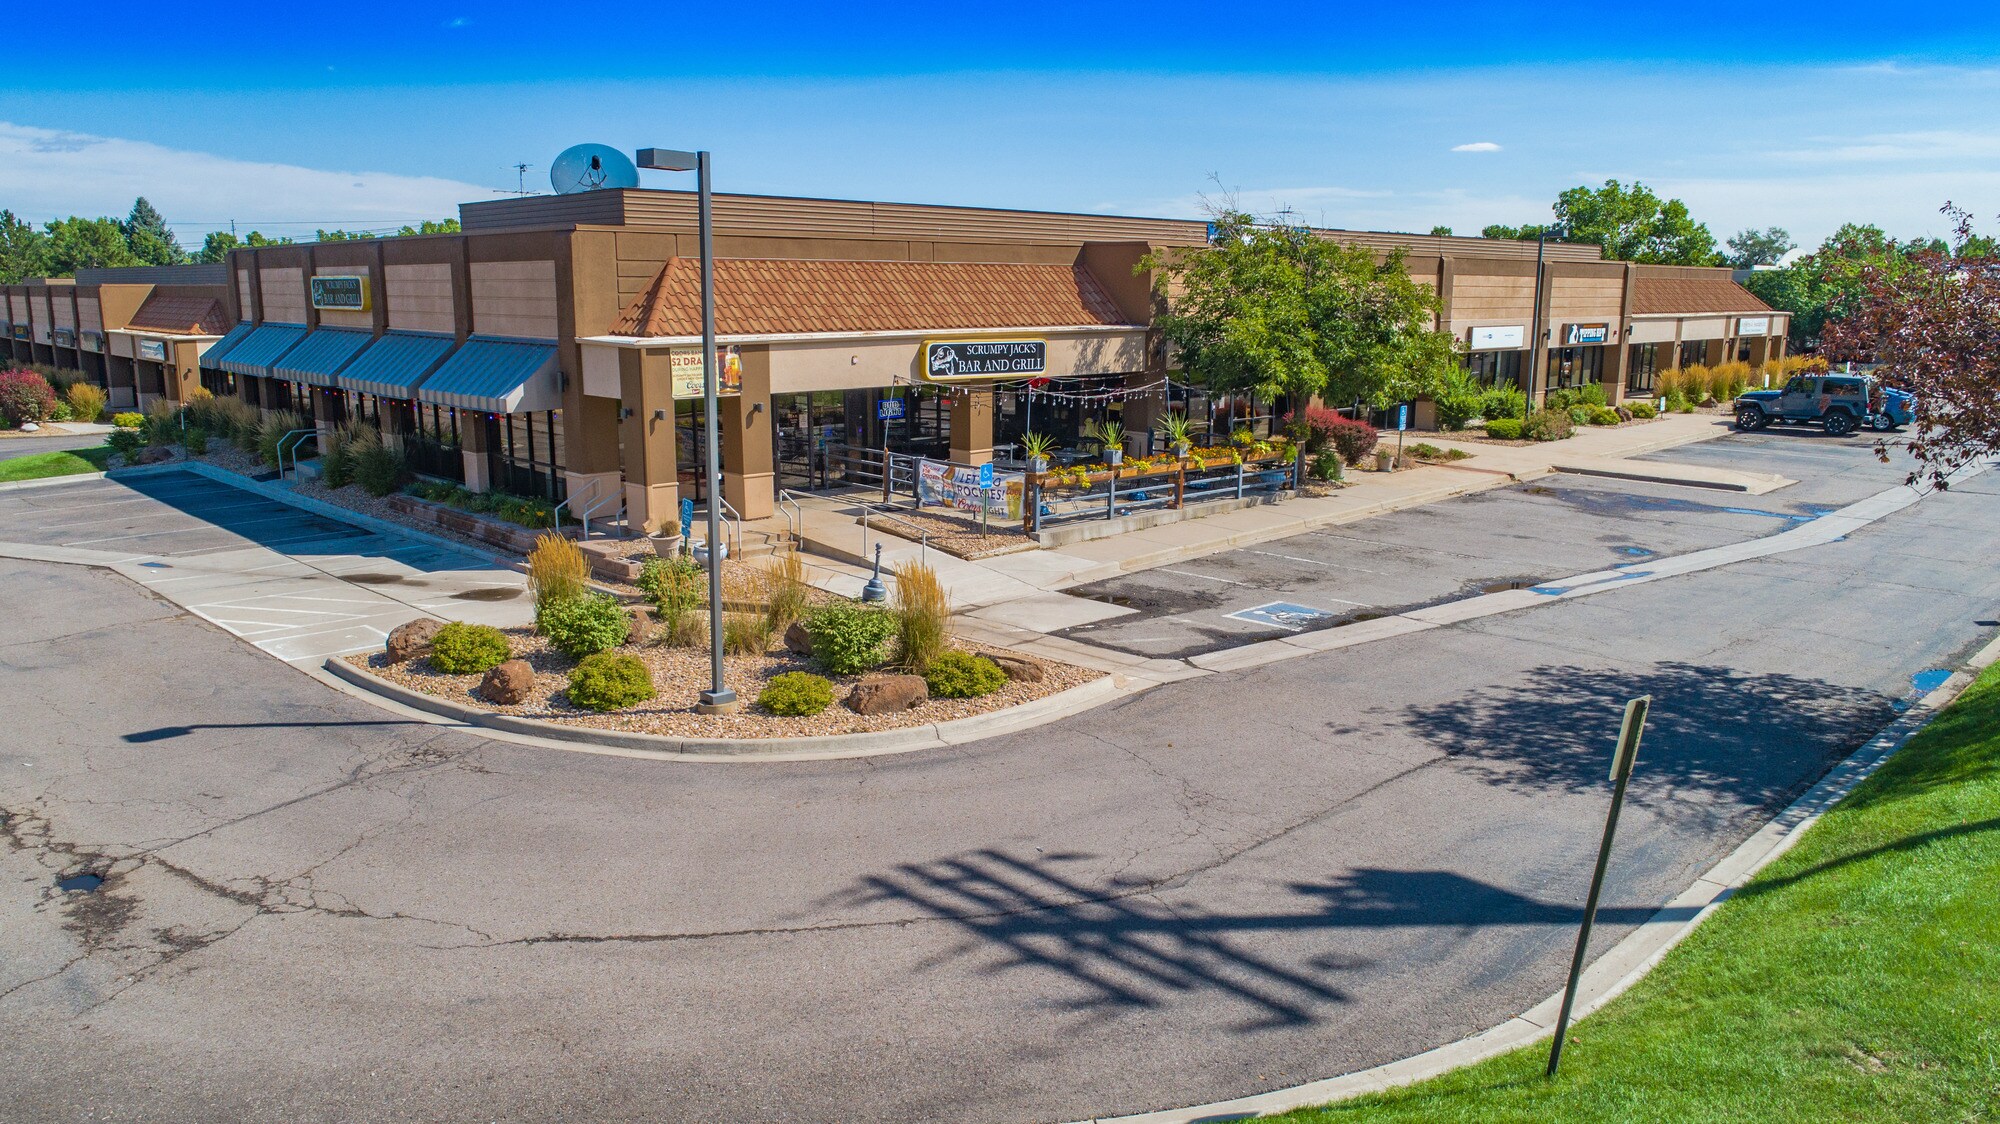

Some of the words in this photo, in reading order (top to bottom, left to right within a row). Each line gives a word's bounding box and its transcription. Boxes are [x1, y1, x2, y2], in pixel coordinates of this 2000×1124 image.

[324, 293, 334, 304] BAR
[335, 293, 345, 304] AND
[346, 293, 361, 304] GRILL
[966, 344, 1009, 356] SCRUMPY
[1009, 343, 1037, 357] JACK'S
[672, 357, 681, 366] $2
[684, 357, 703, 366] DRA
[958, 360, 982, 373] BAR
[984, 359, 1010, 372] AND
[1012, 358, 1044, 371] GRILL
[959, 473, 980, 485] LET'
